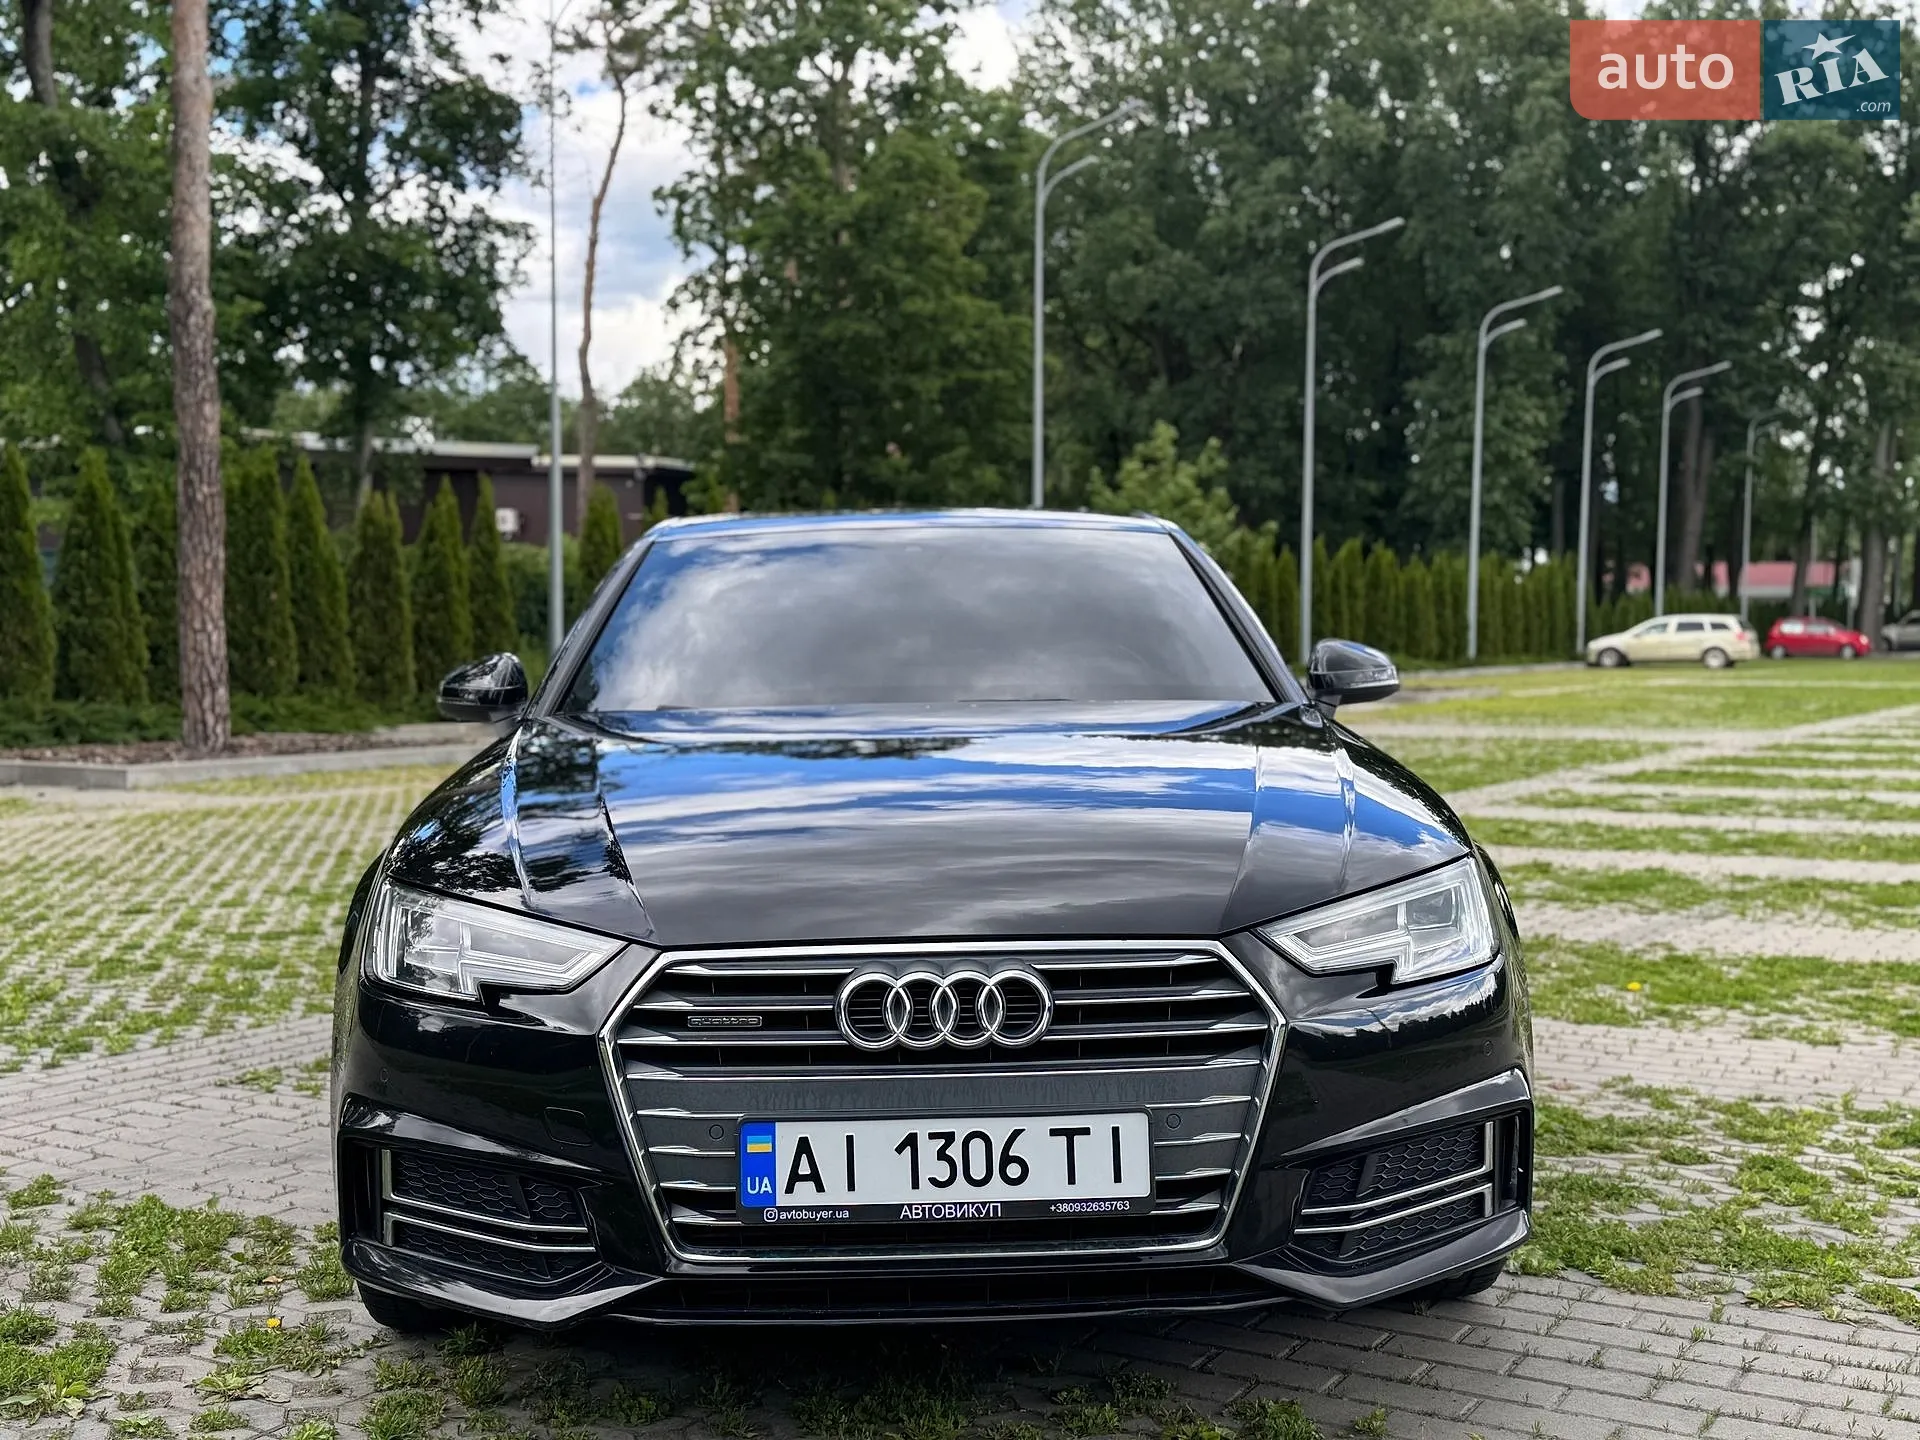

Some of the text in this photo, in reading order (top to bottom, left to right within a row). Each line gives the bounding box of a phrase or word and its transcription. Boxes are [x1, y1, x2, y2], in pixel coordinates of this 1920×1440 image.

[784, 1126, 1122, 1194] AI 1306 TI
[746, 1176, 773, 1195] UA
[779, 1208, 849, 1220] avtobuyer.ua
[900, 1203, 1002, 1220] АВТОВИКУП
[1049, 1200, 1130, 1213] +380932635763
